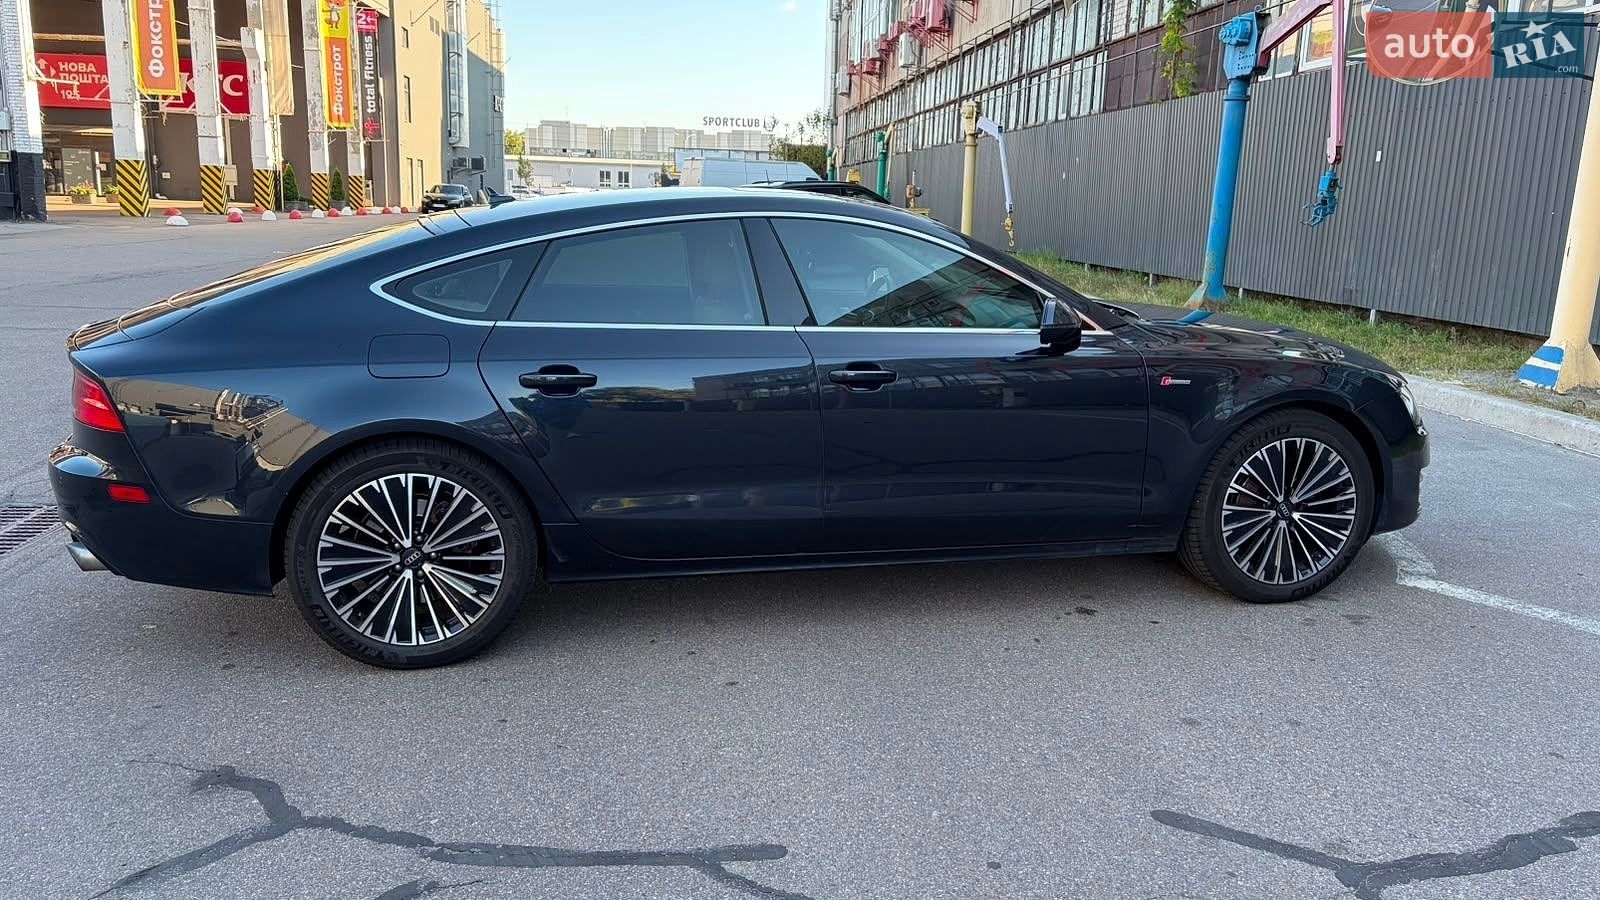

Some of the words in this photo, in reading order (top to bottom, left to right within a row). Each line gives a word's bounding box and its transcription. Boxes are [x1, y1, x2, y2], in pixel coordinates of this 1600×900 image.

[58, 61, 97, 73] НОВА
[365, 36, 374, 80] fitness
[59, 72, 109, 84] ПОШТА
[332, 46, 344, 115] Фокстрот
[365, 84, 376, 113] total
[702, 116, 760, 128] SPORTCLUB
